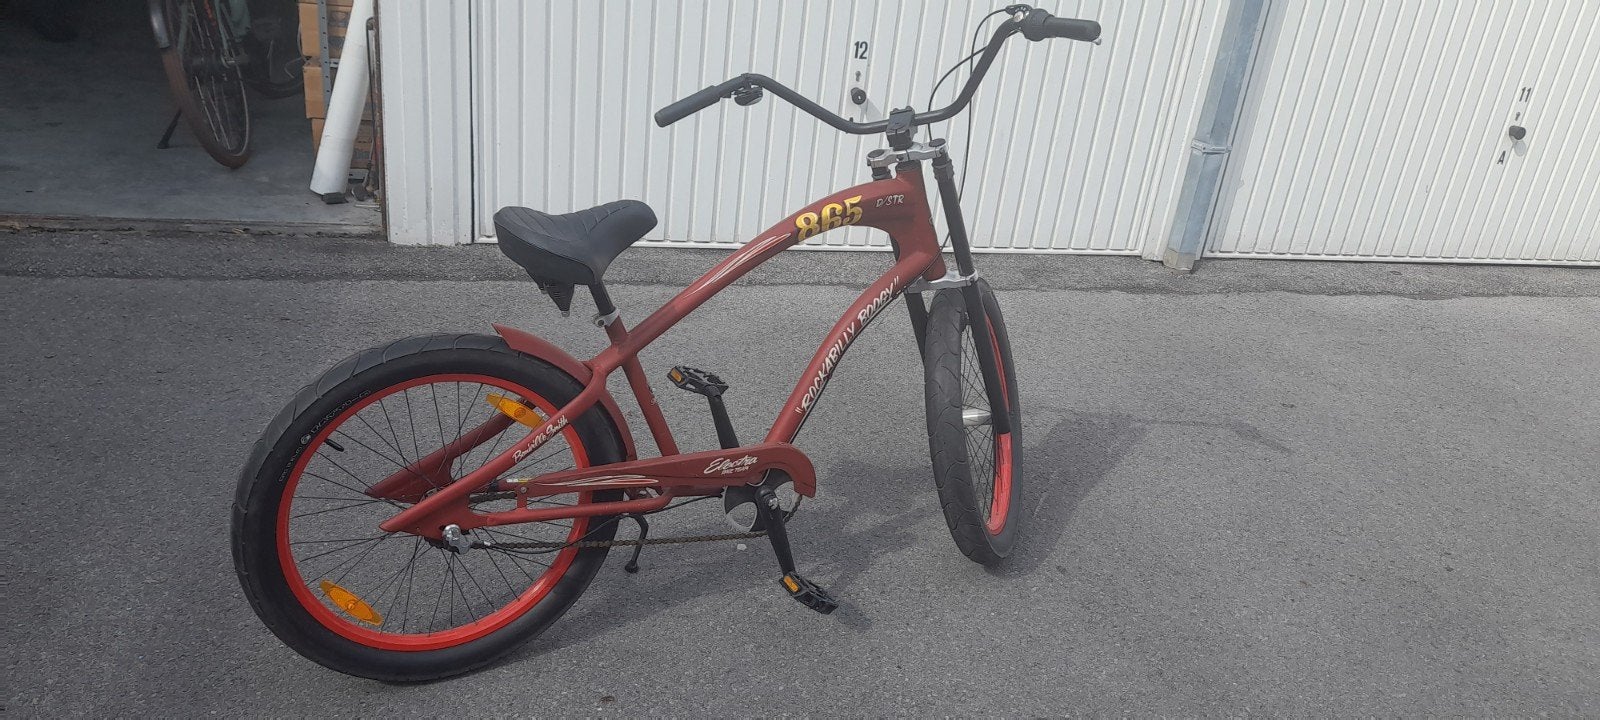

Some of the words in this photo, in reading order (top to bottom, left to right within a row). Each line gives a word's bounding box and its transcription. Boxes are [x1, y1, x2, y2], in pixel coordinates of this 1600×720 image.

[854, 41, 868, 59] 12
[1519, 87, 1531, 102] 11
[1497, 151, 1506, 164] A
[795, 195, 863, 241] 865
[704, 455, 758, 474] Electra
